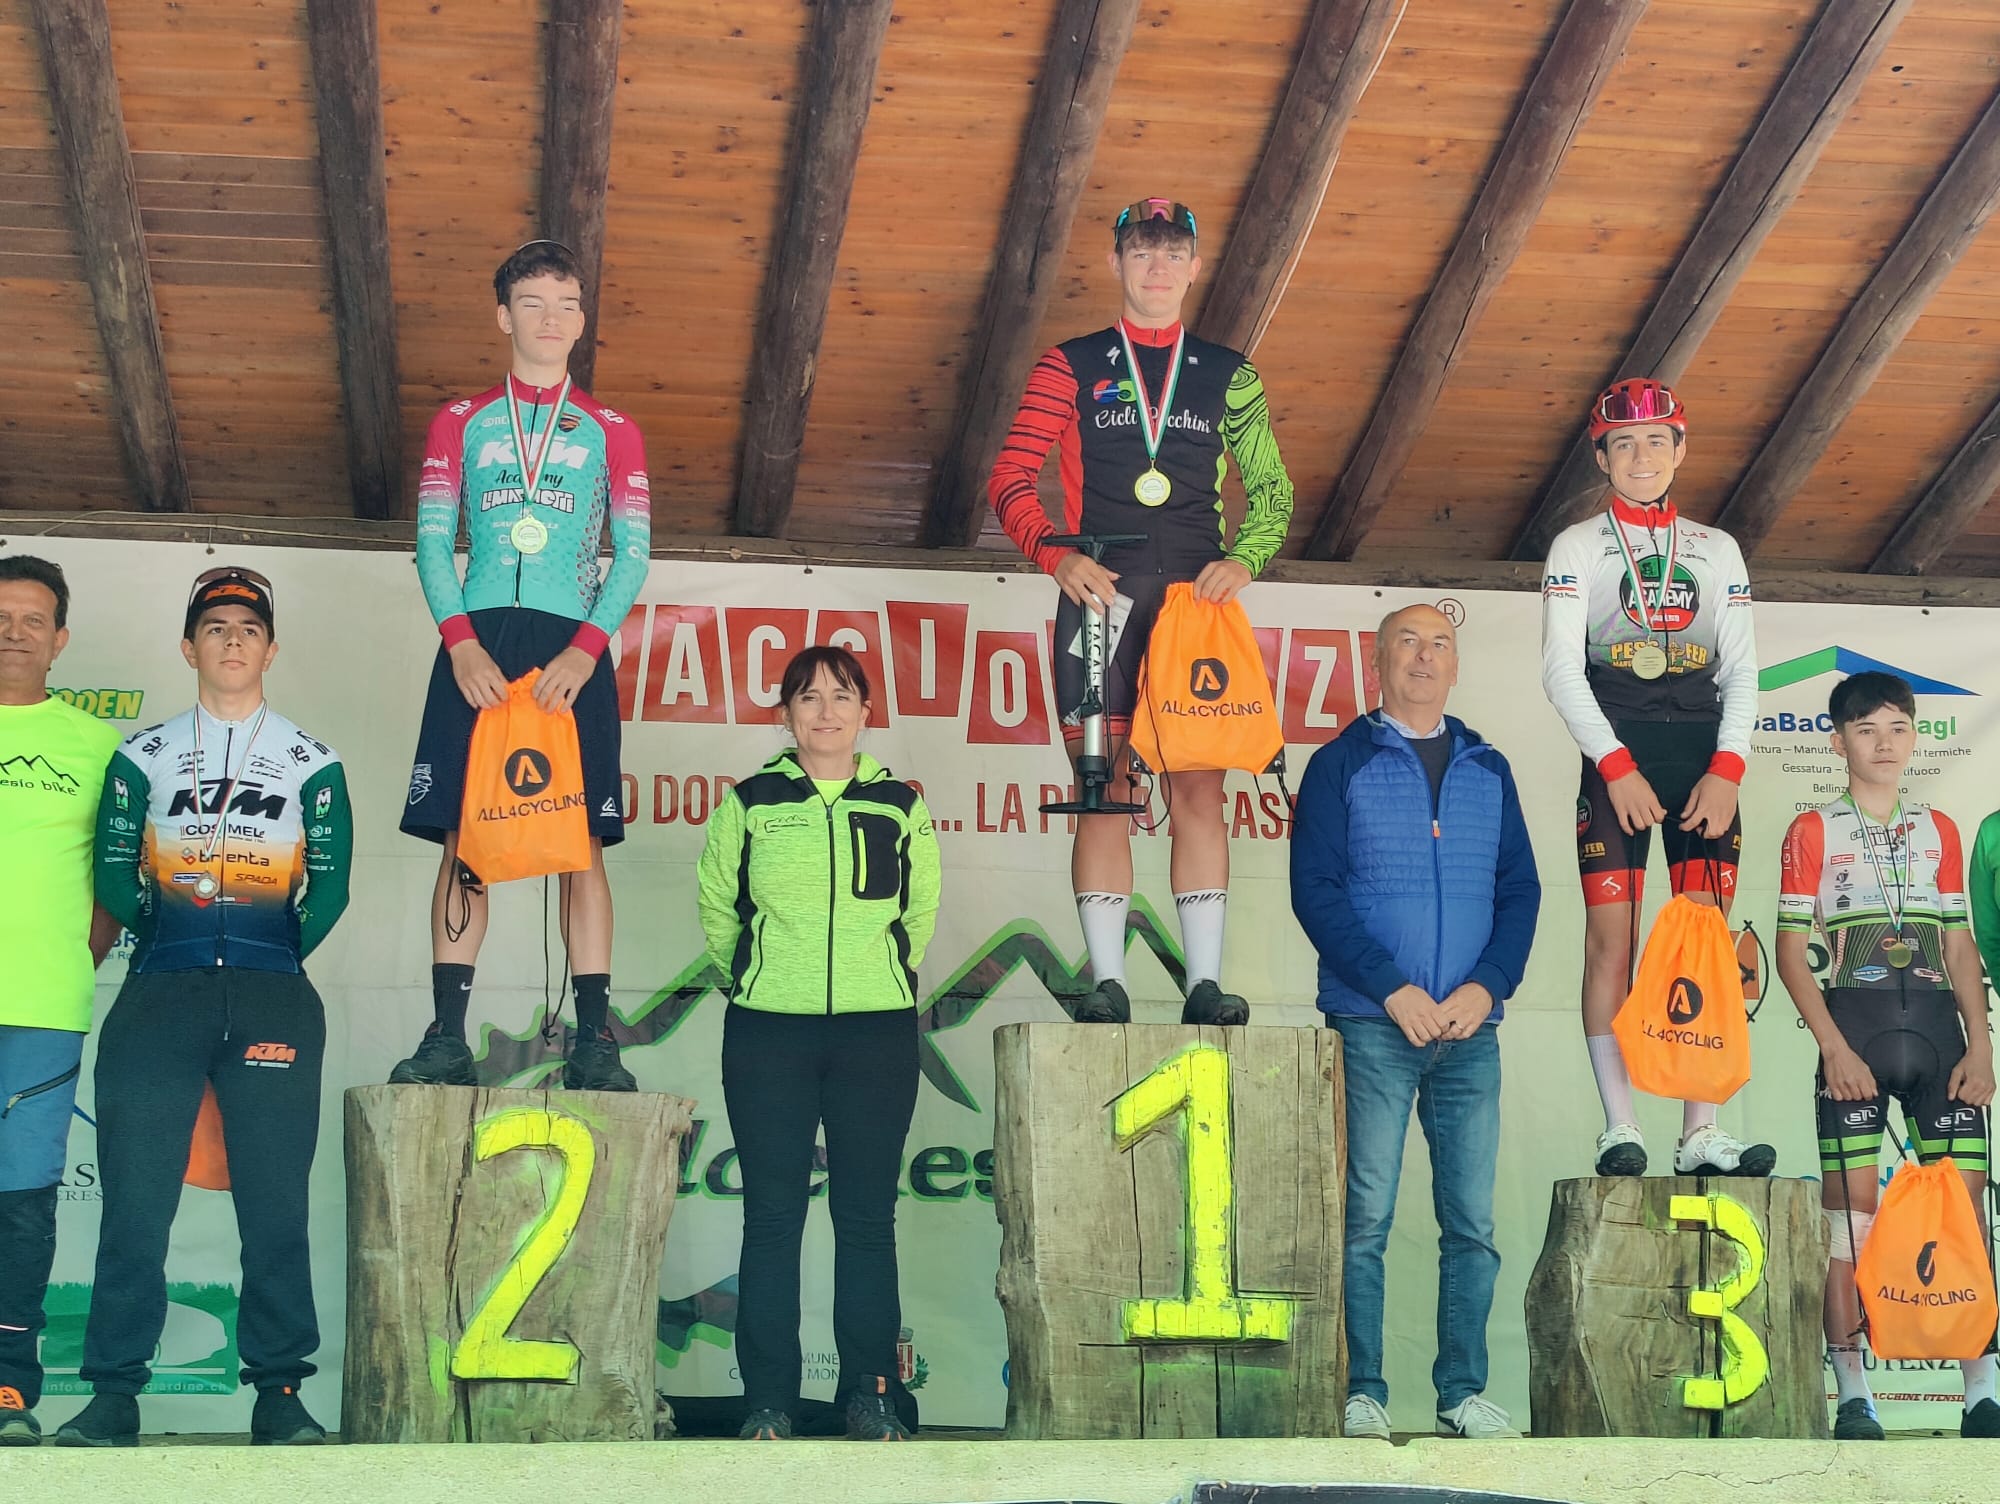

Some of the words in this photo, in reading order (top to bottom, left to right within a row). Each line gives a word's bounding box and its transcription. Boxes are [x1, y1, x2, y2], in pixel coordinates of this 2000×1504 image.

[450, 400, 473, 417] SLP
[600, 408, 625, 425] SLP
[1095, 406, 1138, 429] Cicli
[1545, 575, 1577, 585] AF
[1161, 700, 1263, 717] ALL4CYCLING
[1917, 716, 1957, 741] agl
[142, 736, 162, 756] SLP
[291, 745, 311, 763] SLP
[1794, 745, 1835, 755] Manute
[1924, 747, 1972, 758] termiche
[1782, 763, 1832, 774] Gessatura
[41, 779, 78, 796] bike
[1813, 783, 1849, 794] Bellinz
[168, 777, 287, 821] KTM
[976, 782, 1027, 834] LA
[1585, 842, 1606, 854] FER
[235, 873, 278, 885] SPADA
[245, 1043, 296, 1062] KTM
[1114, 1048, 1294, 1341] 1
[452, 1108, 595, 1380] 2
[1670, 1193, 1768, 1410] 3
